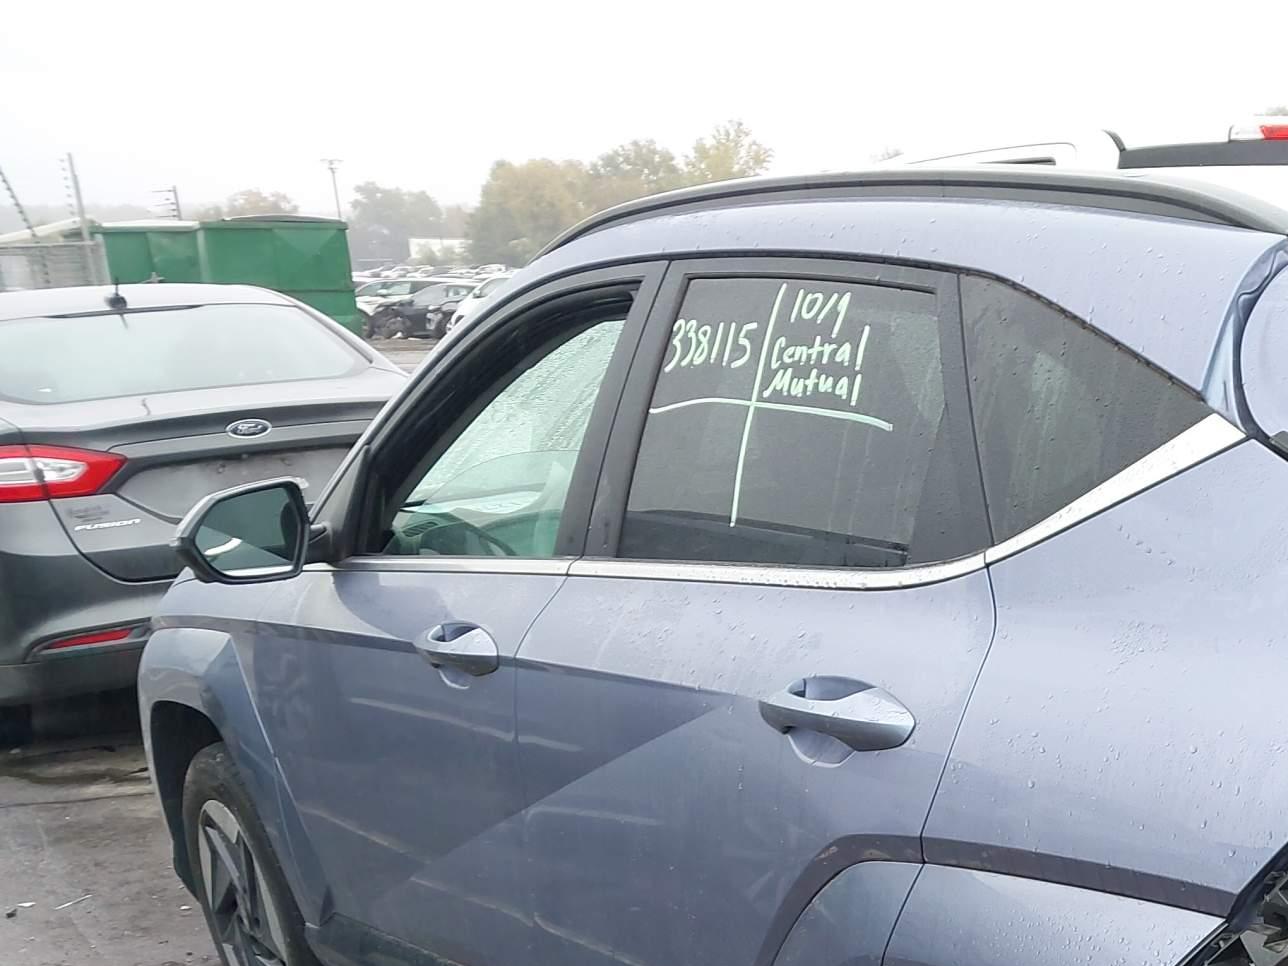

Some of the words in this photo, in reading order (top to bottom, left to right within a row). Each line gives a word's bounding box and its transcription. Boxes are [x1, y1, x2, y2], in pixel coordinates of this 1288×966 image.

[789, 288, 852, 339] 10/9
[664, 318, 758, 374] 338115
[770, 324, 871, 371] Central
[762, 367, 862, 406] Mutual
